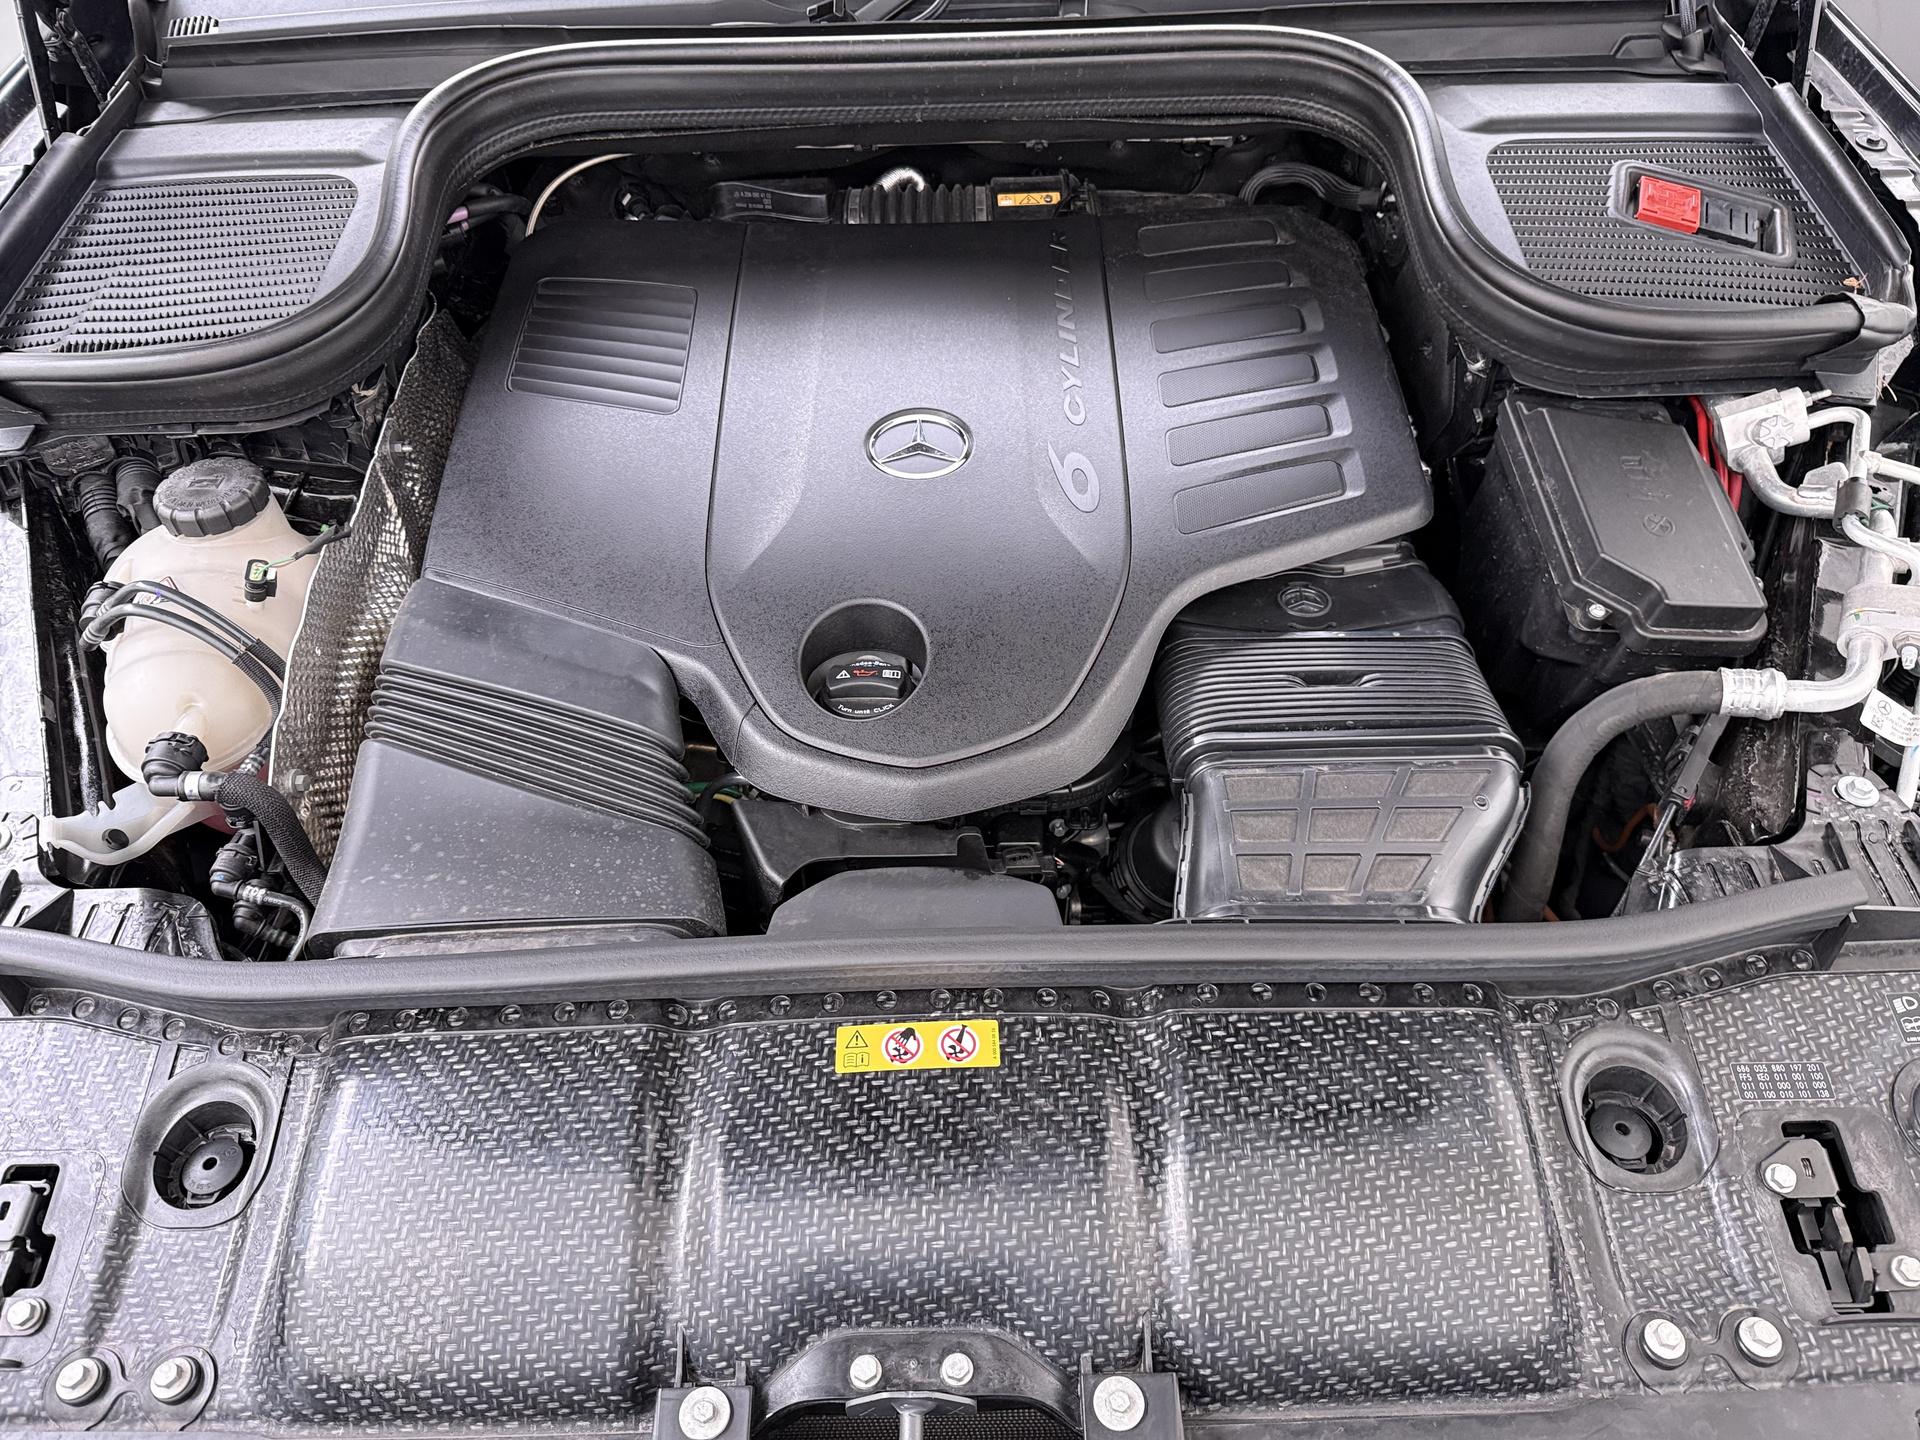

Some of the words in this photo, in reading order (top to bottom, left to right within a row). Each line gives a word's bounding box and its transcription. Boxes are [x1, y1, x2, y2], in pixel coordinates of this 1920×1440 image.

[1047, 440, 1101, 513] 6
[838, 704, 853, 713] Turn
[873, 703, 895, 713] CLICK
[1736, 1064, 1750, 1073] 686
[1753, 1064, 1768, 1073] 035
[1789, 1063, 1802, 1072] 197
[1806, 1063, 1820, 1072] 201
[1773, 1073, 1788, 1081] 011
[1791, 1072, 1806, 1081] 001
[1810, 1072, 1824, 1080] 100
[1741, 1082, 1755, 1090] 011
[1759, 1082, 1773, 1090] 011
[1776, 1082, 1791, 1090] 000
[1795, 1081, 1809, 1089] 101
[1812, 1081, 1827, 1089] 000
[1744, 1091, 1758, 1099] 001
[1762, 1091, 1777, 1099] 100
[1779, 1090, 1794, 1098] 010
[1798, 1090, 1812, 1098] 101
[1816, 1089, 1830, 1098] 138
